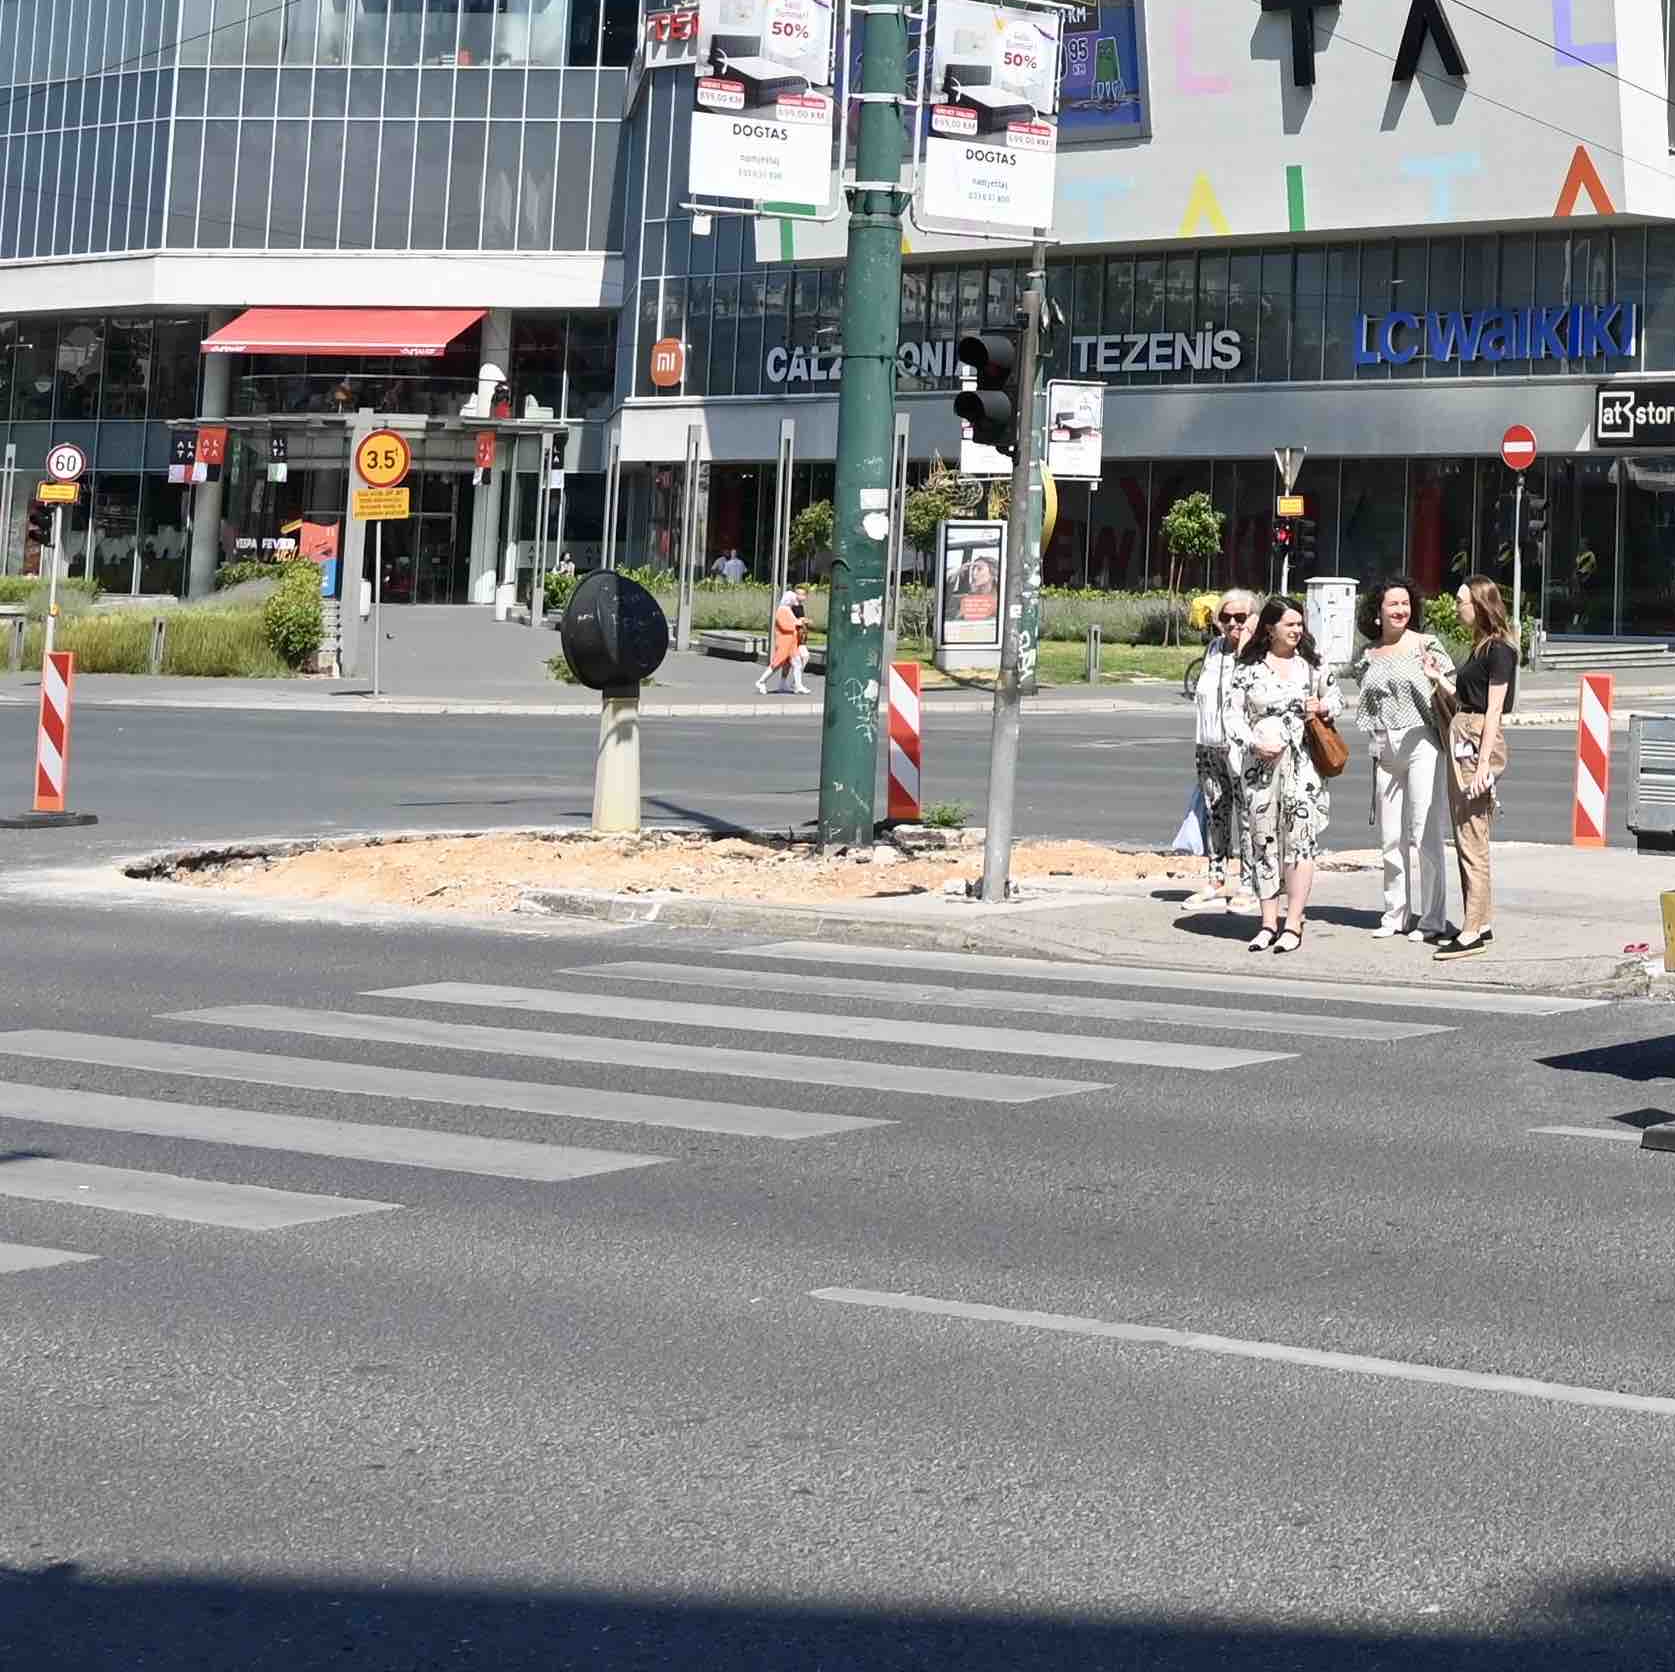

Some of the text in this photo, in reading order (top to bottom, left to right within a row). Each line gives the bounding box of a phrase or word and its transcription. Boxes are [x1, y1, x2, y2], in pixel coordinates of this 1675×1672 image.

[771, 21, 809, 39] 50%
[1004, 51, 1038, 69] 50%
[1603, 401, 1622, 425] at
[56, 455, 76, 471] 60
